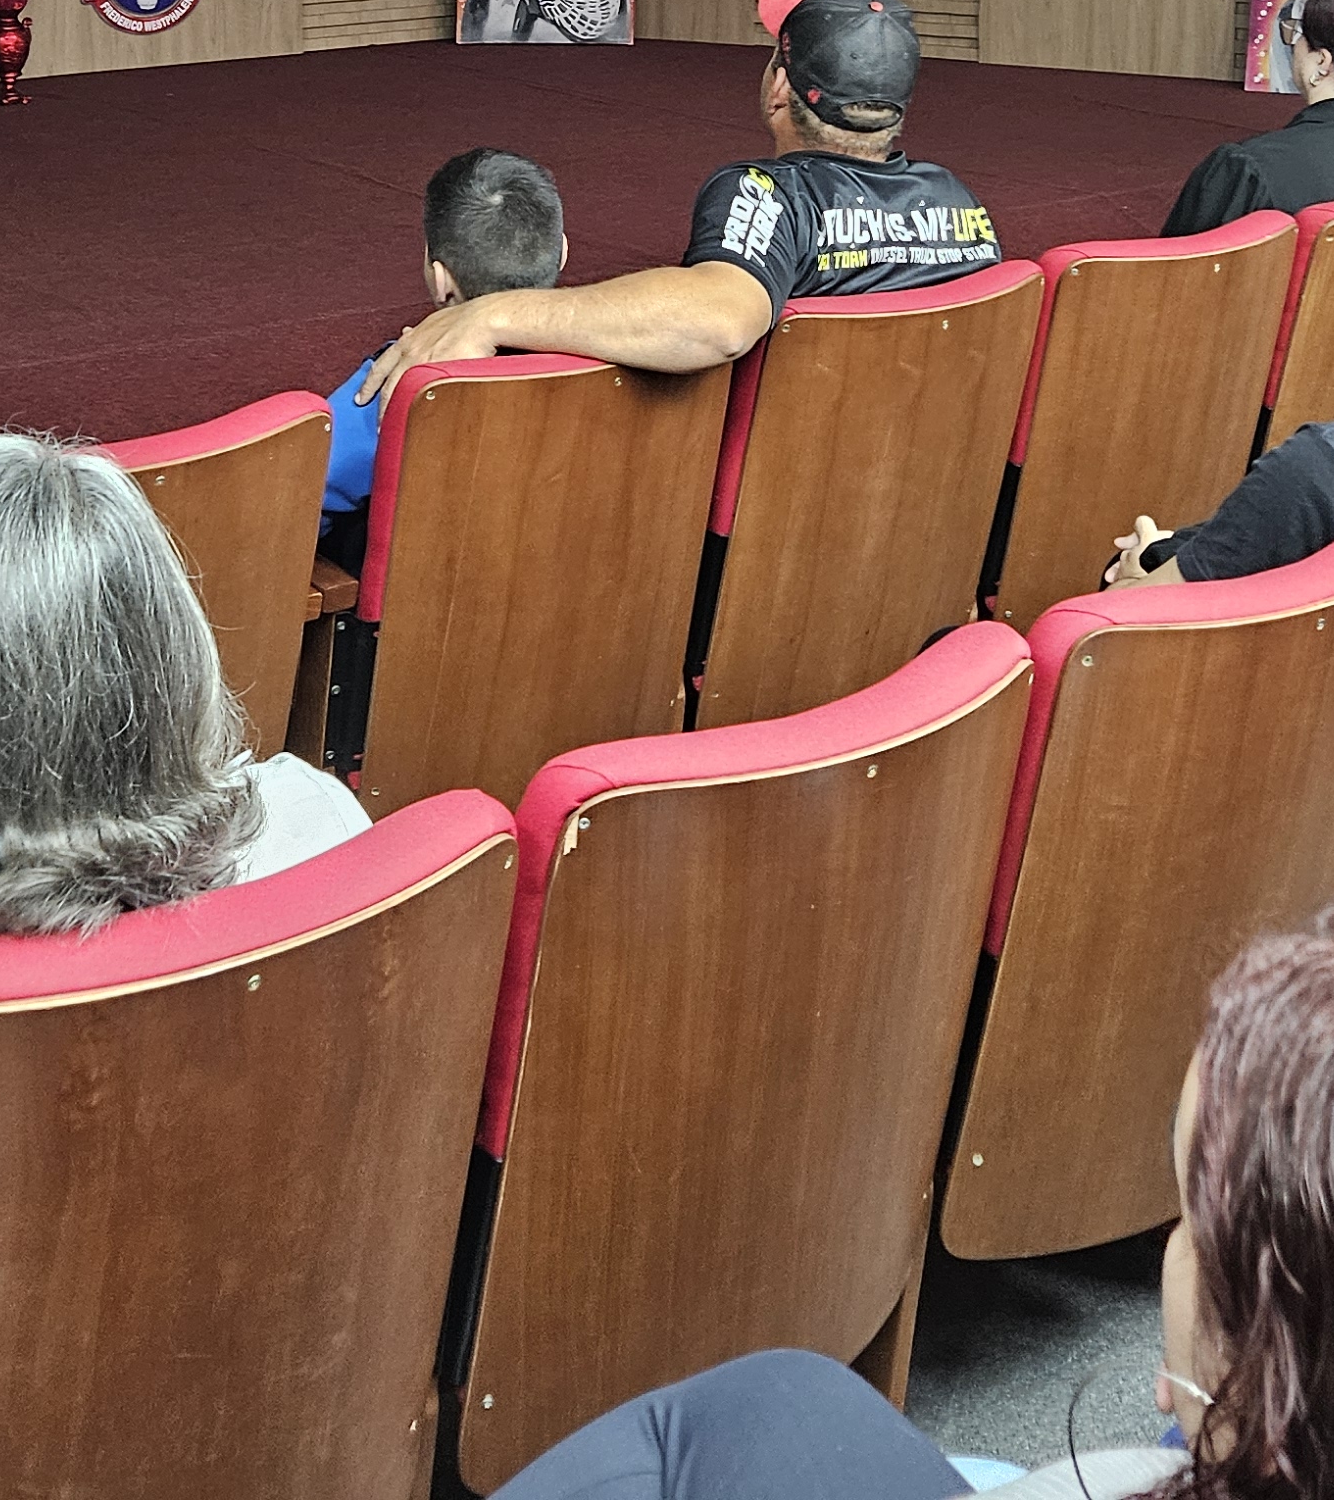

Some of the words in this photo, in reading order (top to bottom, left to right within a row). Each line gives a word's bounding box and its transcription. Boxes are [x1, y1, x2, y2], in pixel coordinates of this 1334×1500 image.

[100, 1, 143, 32] FREDERICO
[721, 195, 755, 255] PRO
[743, 191, 784, 268] TORK
[884, 212, 907, 242] IS
[951, 206, 997, 244] LIFE
[870, 246, 908, 265] DIESEL
[909, 246, 939, 265] TRUCK
[936, 247, 963, 265] STOP
